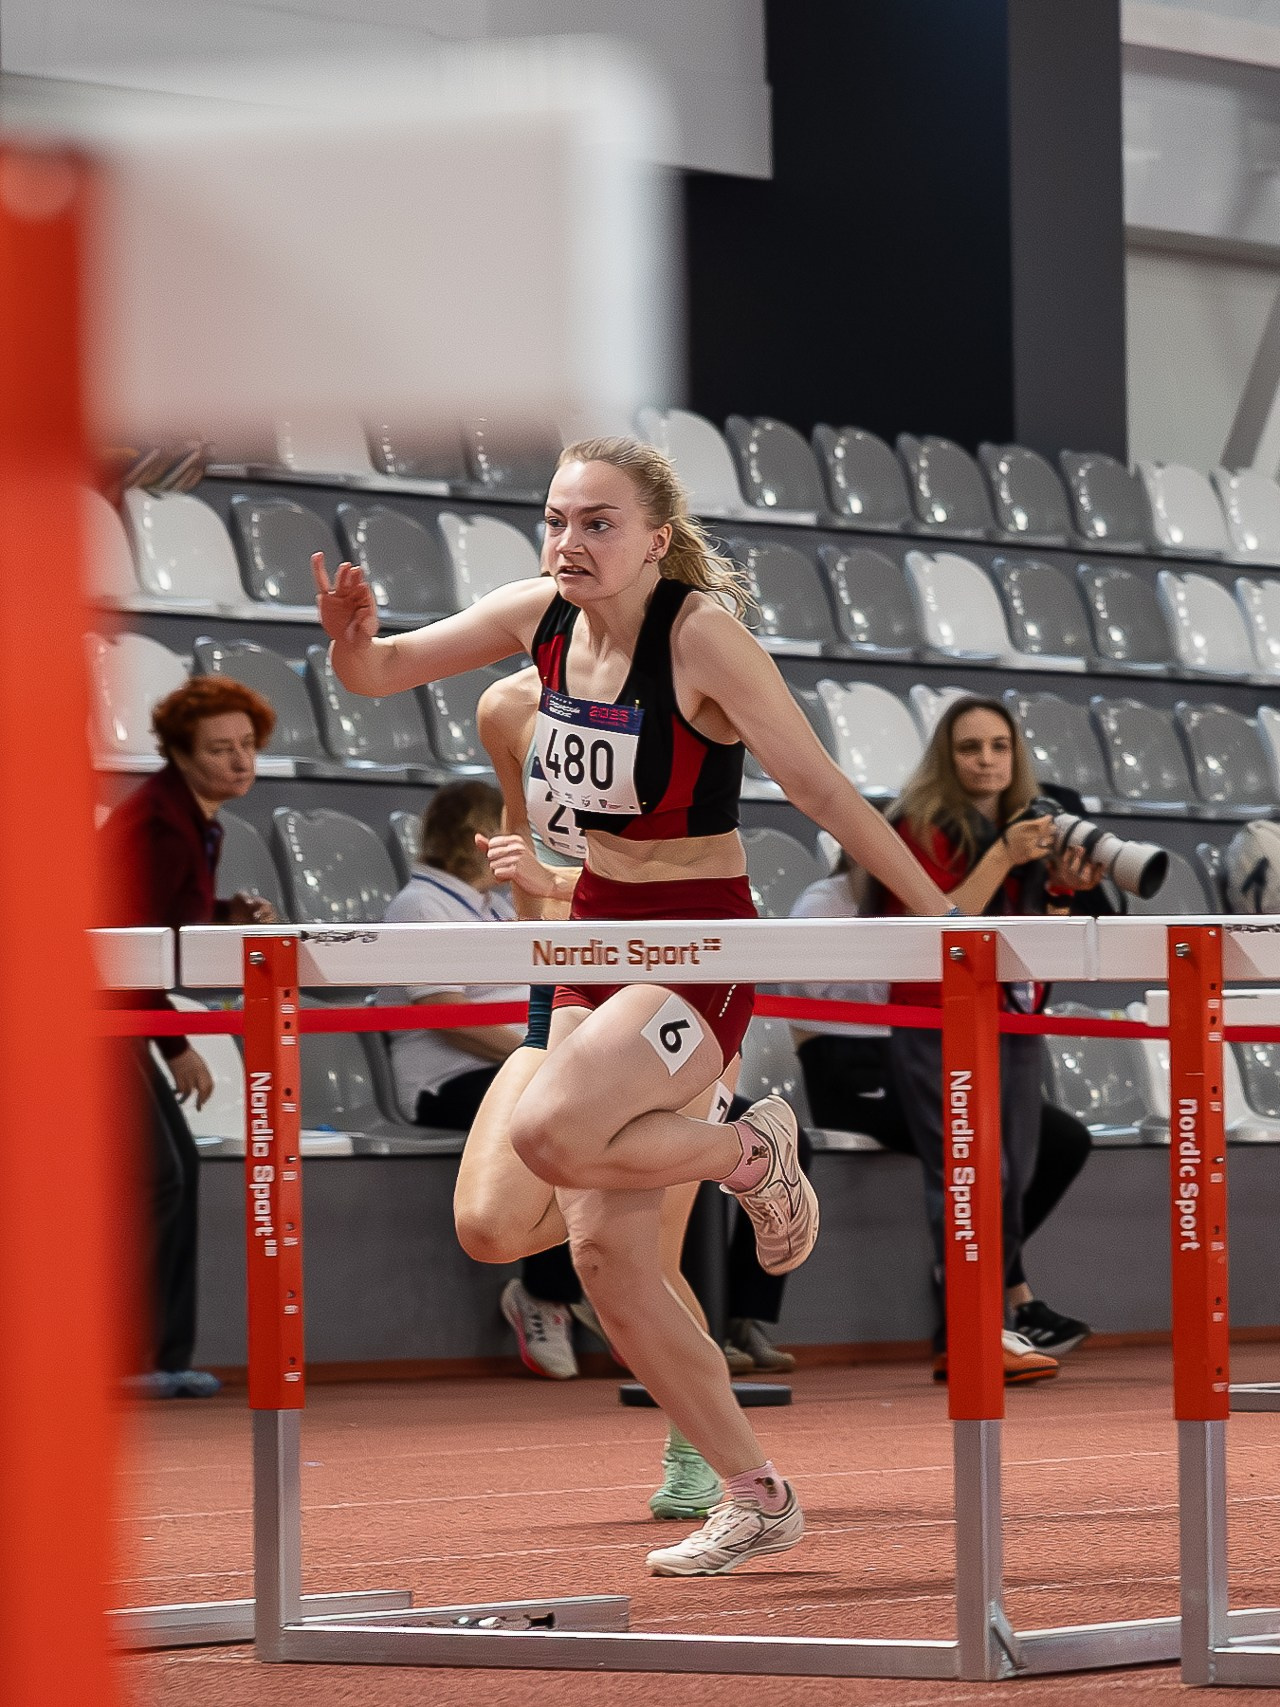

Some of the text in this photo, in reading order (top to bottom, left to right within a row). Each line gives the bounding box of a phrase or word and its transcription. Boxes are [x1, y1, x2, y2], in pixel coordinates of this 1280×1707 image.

[545, 728, 614, 790] 480
[532, 938, 700, 971] Nordic Sport
[659, 1019, 690, 1053] 6
[249, 1072, 275, 1237] Nordic Sport
[949, 1070, 976, 1241] Nordic Sport
[1175, 1182, 1201, 1251] Sport
